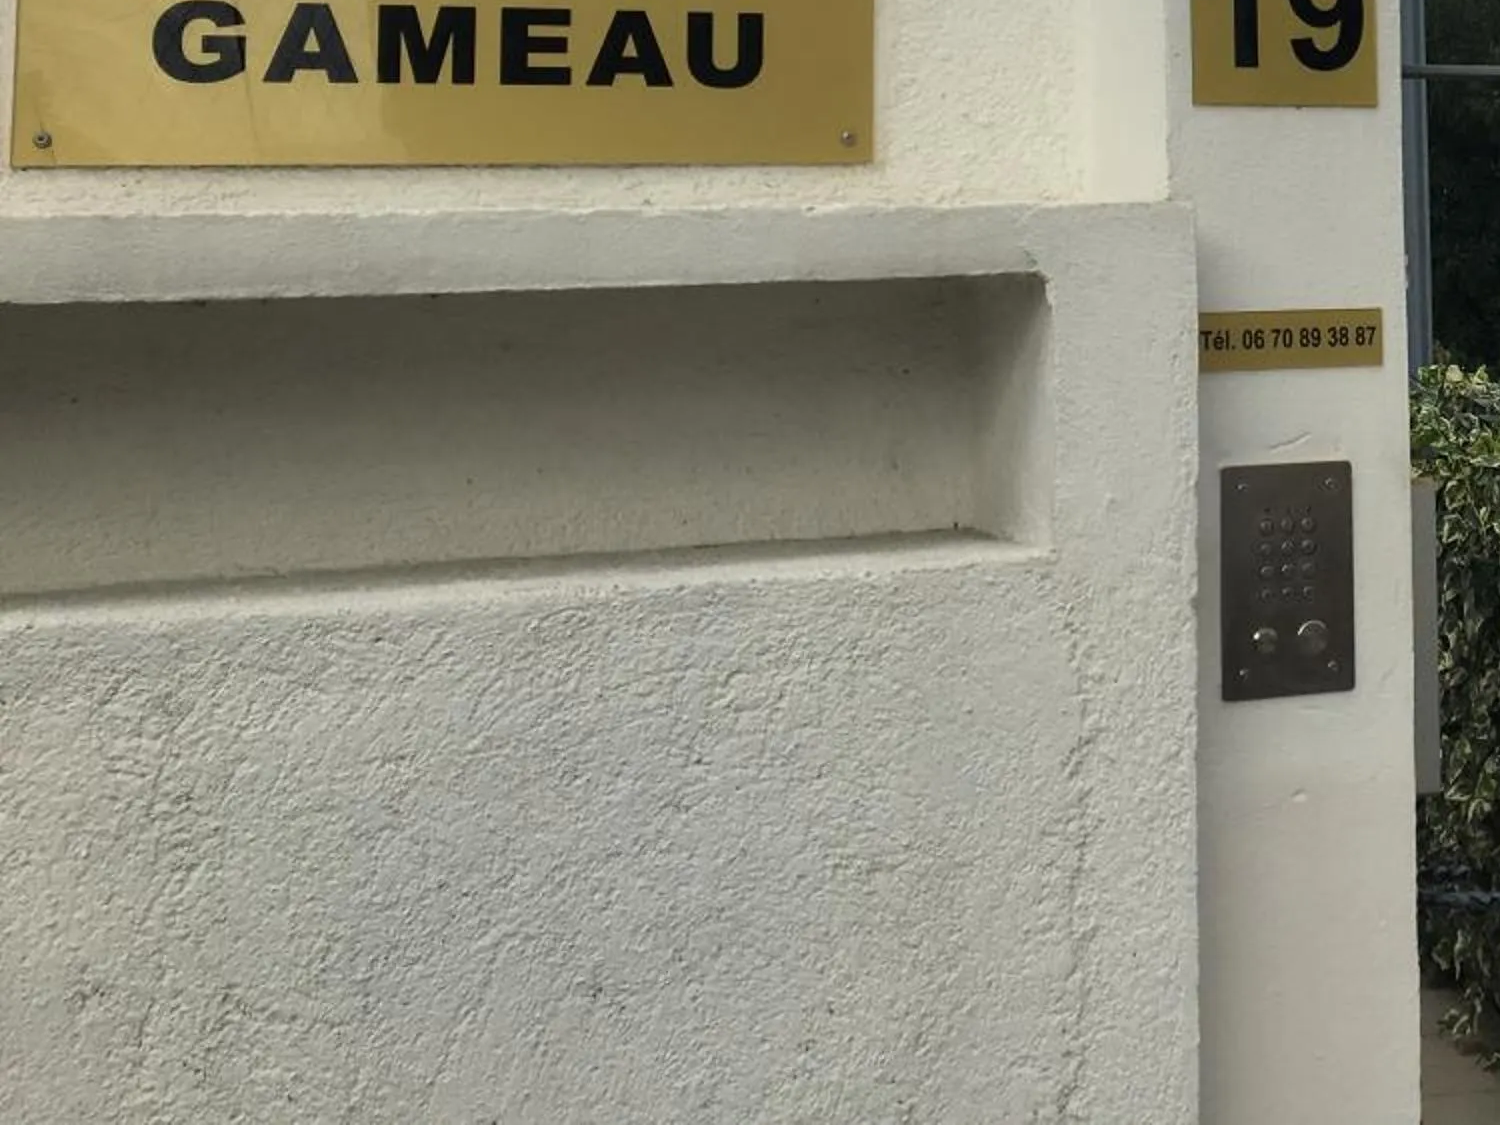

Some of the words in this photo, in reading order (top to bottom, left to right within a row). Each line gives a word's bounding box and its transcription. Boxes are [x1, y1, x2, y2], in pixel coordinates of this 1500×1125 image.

[1199, 329, 1236, 351] Tél.
[1242, 328, 1265, 350] 06
[1271, 328, 1293, 349] 70
[1299, 327, 1322, 348] 89
[1327, 326, 1349, 347] 38
[1355, 325, 1377, 346] 87
